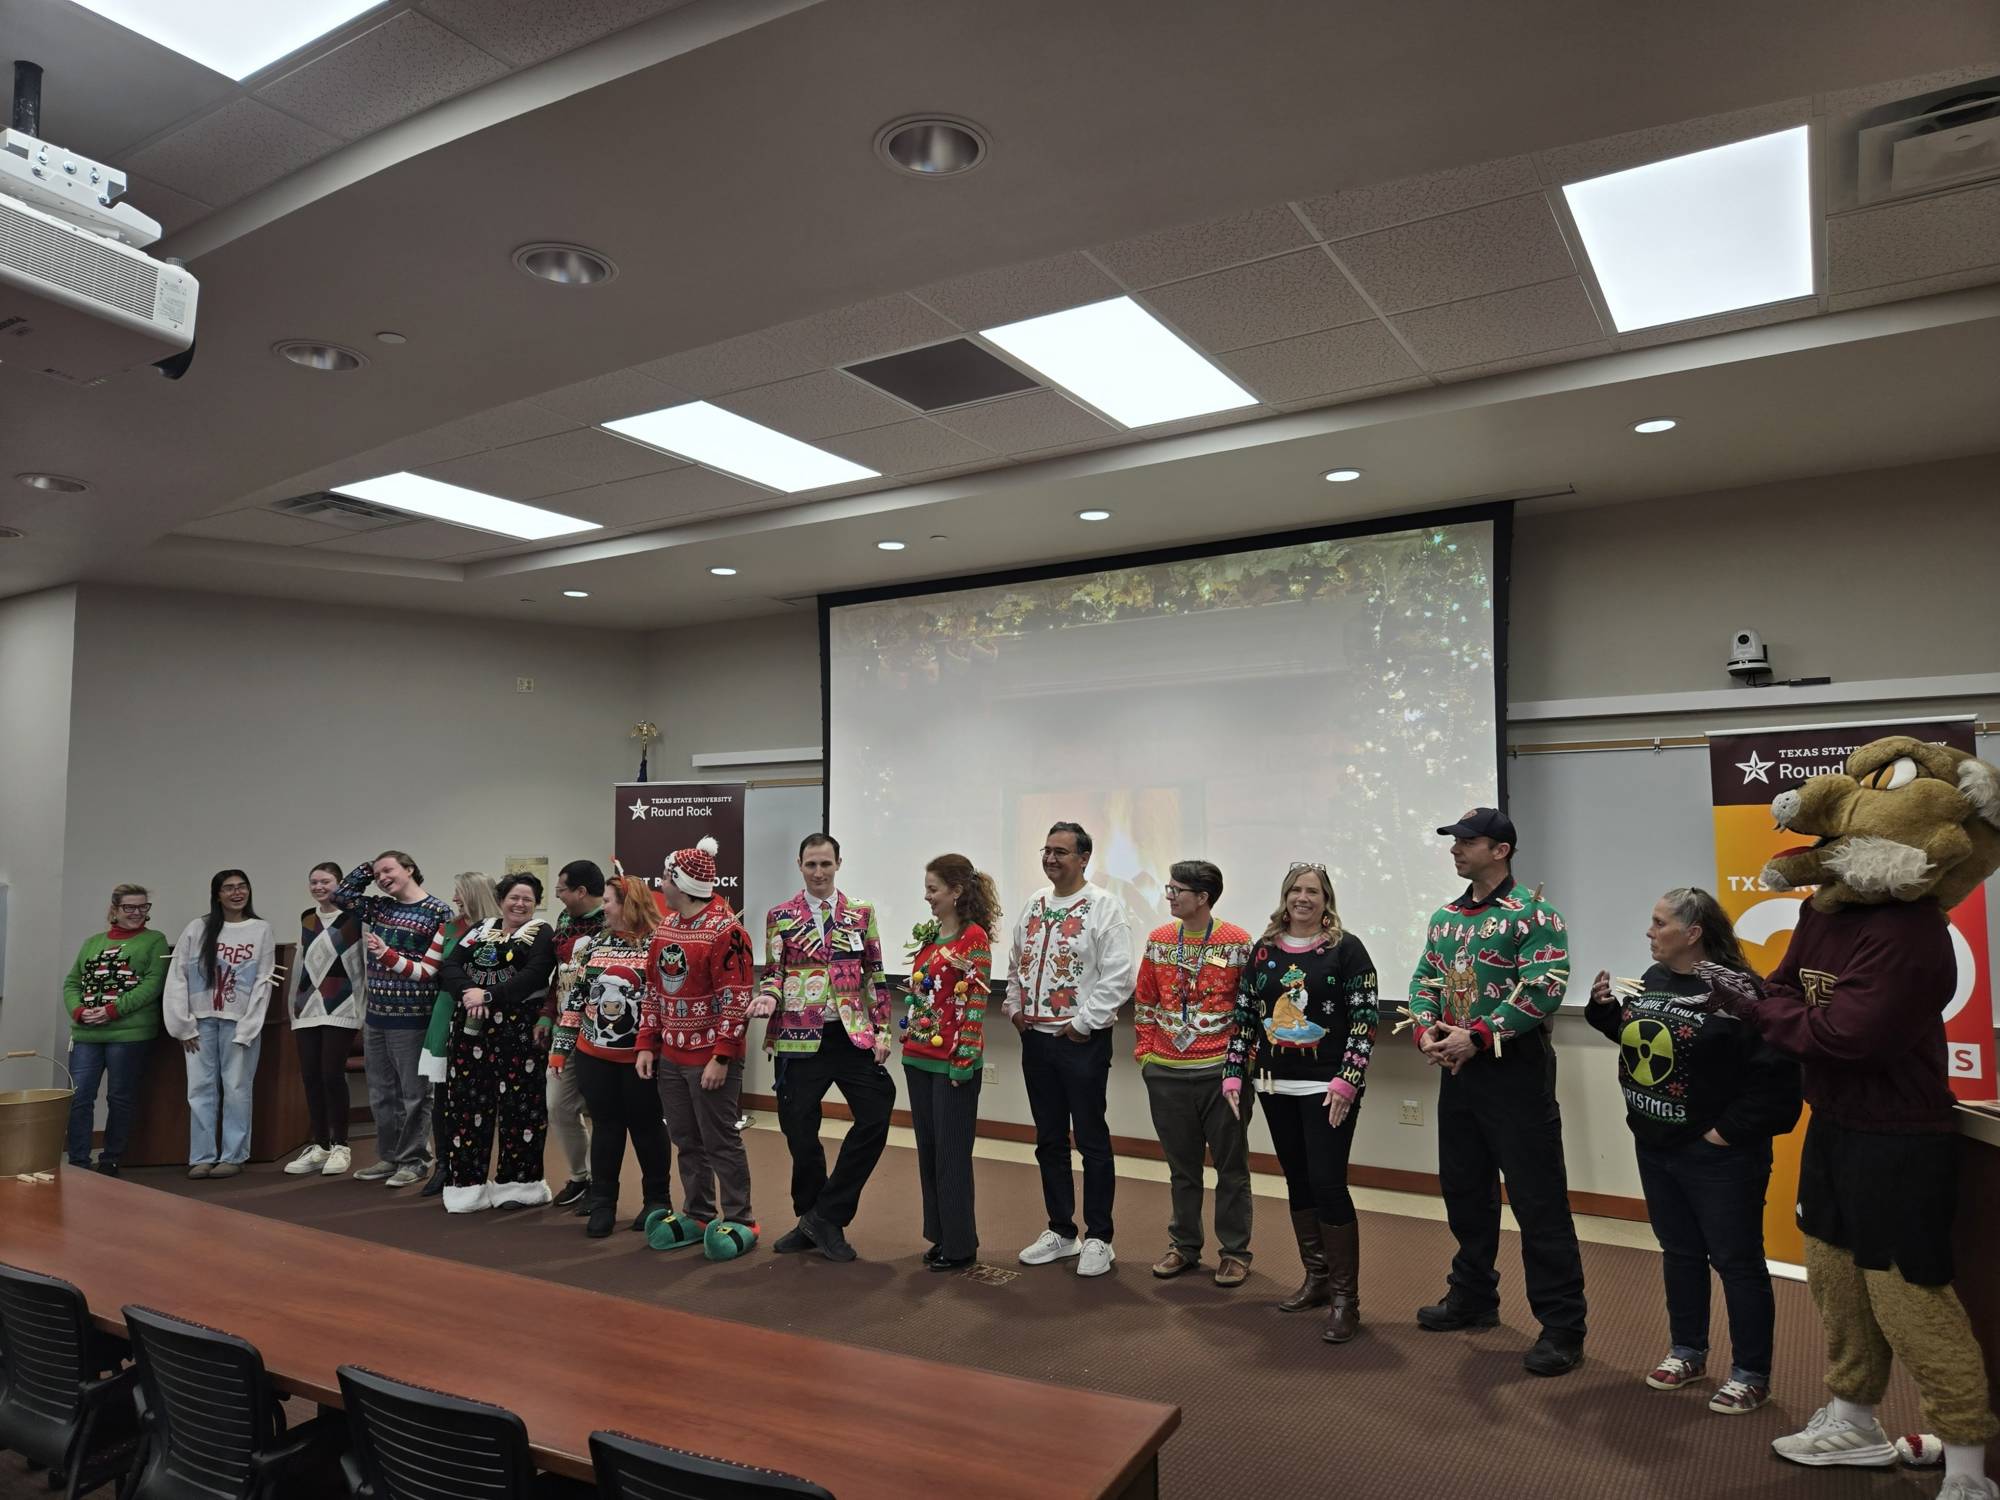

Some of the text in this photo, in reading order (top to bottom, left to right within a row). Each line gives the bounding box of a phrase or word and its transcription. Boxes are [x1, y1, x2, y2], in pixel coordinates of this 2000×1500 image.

[1779, 748, 1819, 758] TEXAS
[1779, 761, 1844, 779] Round
[651, 806, 712, 817] Round Rock
[712, 876, 738, 887] OCK
[1727, 876, 1770, 891] TXS
[216, 942, 254, 964] PRÈS
[1167, 945, 1223, 965] GINCH
[1363, 972, 1376, 989] HO
[1350, 1022, 1368, 1036] HO
[1343, 1066, 1362, 1084] HO
[1623, 1087, 1686, 1118] RISTMAS
